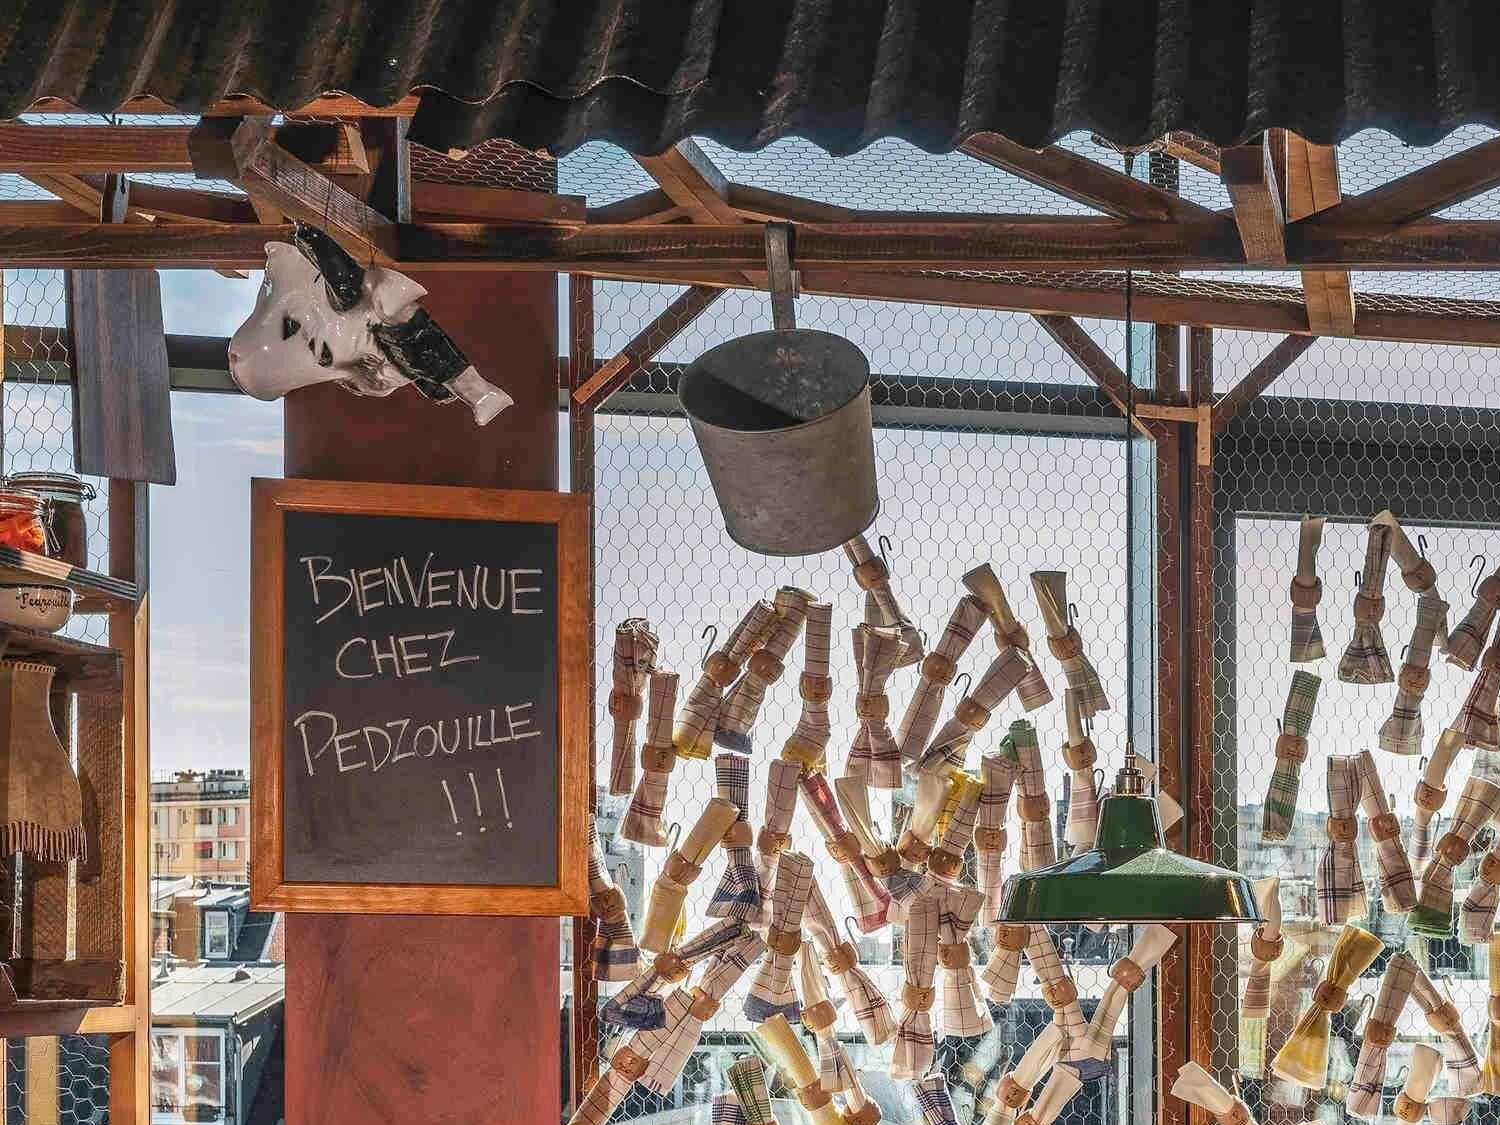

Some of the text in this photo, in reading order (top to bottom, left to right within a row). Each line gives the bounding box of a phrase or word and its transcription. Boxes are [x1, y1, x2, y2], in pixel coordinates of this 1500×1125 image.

[300, 552, 544, 624] BIENVENUE
[335, 630, 480, 679] CHEZ
[294, 702, 541, 777] PEDZOUILLE
